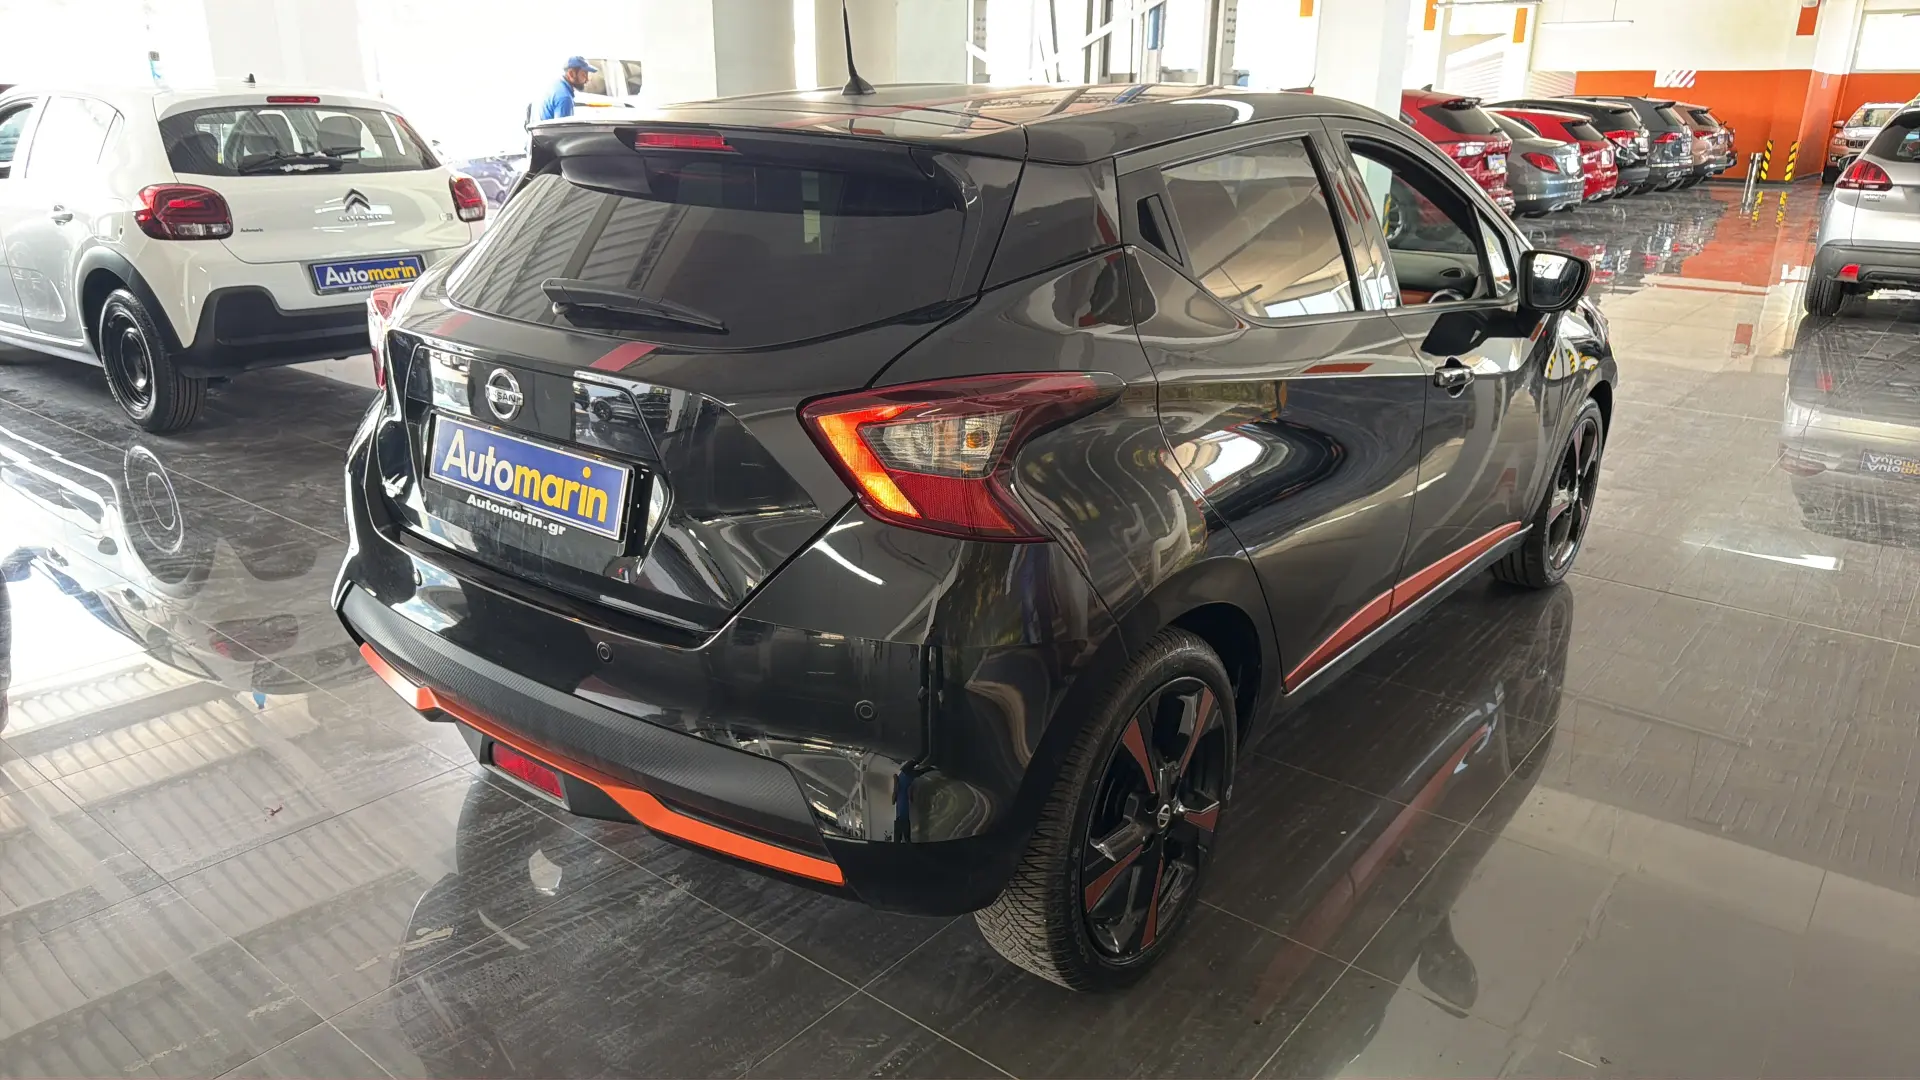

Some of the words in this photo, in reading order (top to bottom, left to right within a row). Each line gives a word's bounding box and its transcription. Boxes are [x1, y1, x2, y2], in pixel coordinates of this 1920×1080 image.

[325, 260, 417, 286] Automarin
[441, 428, 609, 523] Automarin
[466, 494, 567, 536] Automarin.gr
